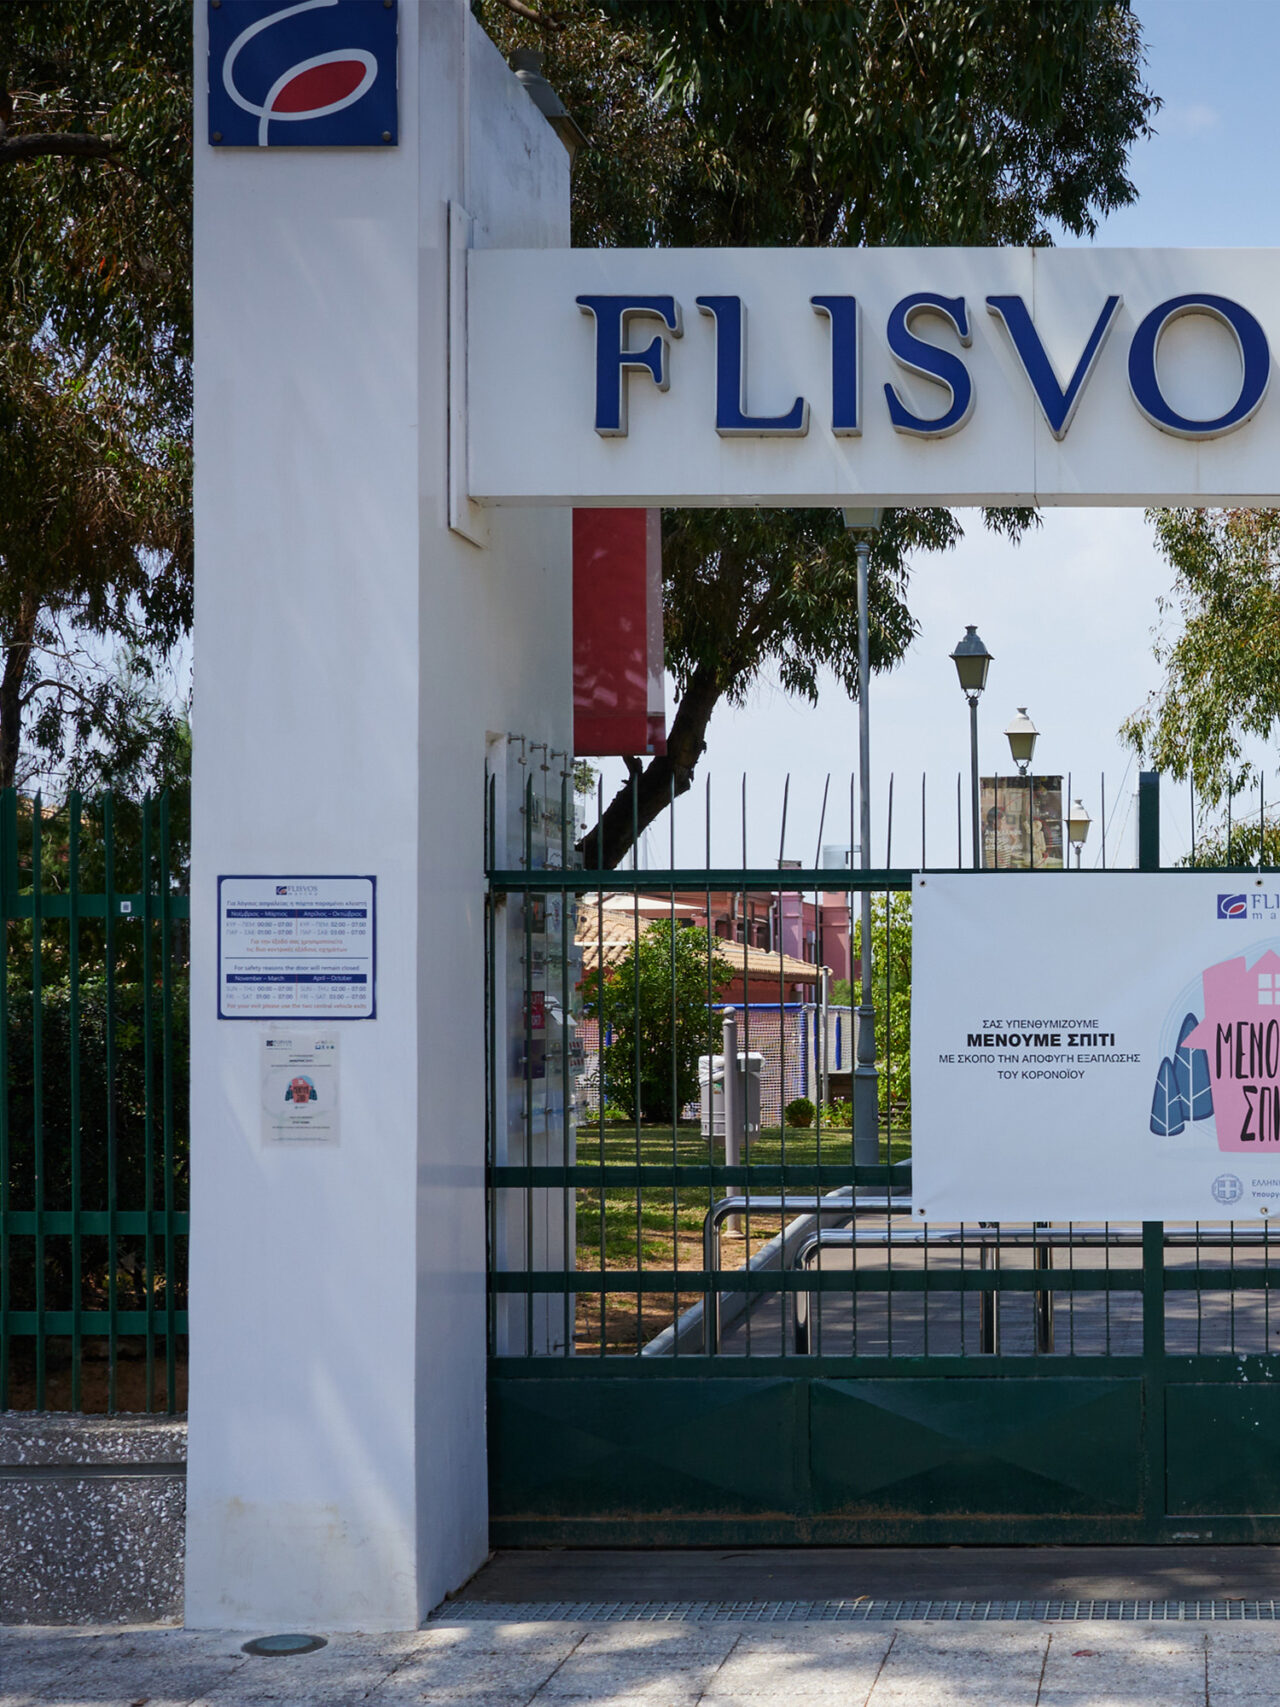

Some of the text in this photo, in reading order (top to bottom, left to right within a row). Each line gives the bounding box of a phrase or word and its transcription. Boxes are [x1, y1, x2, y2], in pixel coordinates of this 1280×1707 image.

[982, 1019, 1099, 1029] ΣΑΣ ΥΠΕΝΘΥΜΙΖΟΥΜΕ
[966, 1032, 1116, 1048] ΜΕΝΟΥΜΕ ΣΠΙΤΙ
[938, 1053, 1141, 1064] ΜΕ ΣΚΟΠΟ ΤΗΝ ΑΠΟΦΥΓΗ ΕΞΑΠΛΩΣΗΣ
[997, 1068, 1086, 1080] ΤΟΥ ΚΟΡΟΝΟΪΟΥ
